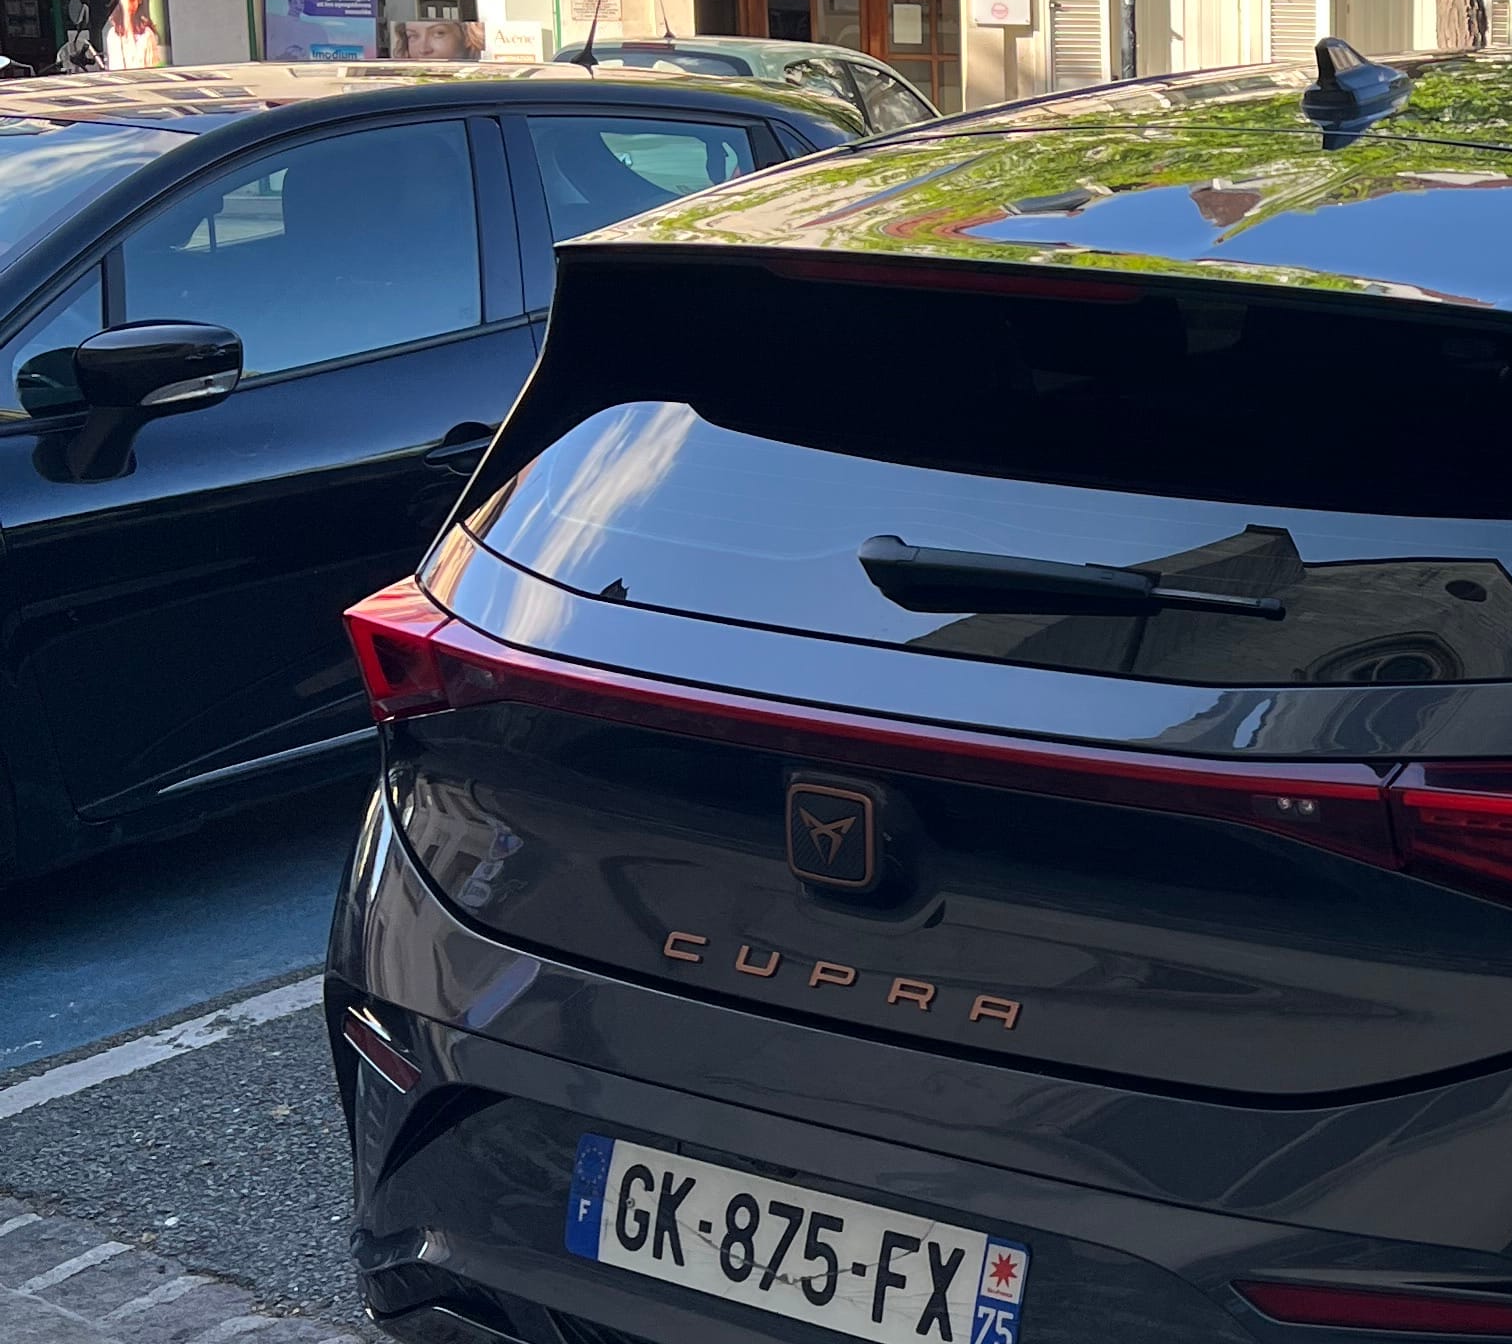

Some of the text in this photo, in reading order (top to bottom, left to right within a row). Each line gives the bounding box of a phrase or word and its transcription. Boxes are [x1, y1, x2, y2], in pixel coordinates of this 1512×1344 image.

[663, 931, 1022, 1029] CUPRA
[578, 1198, 592, 1222] F
[615, 1164, 966, 1342] GK-875-FX
